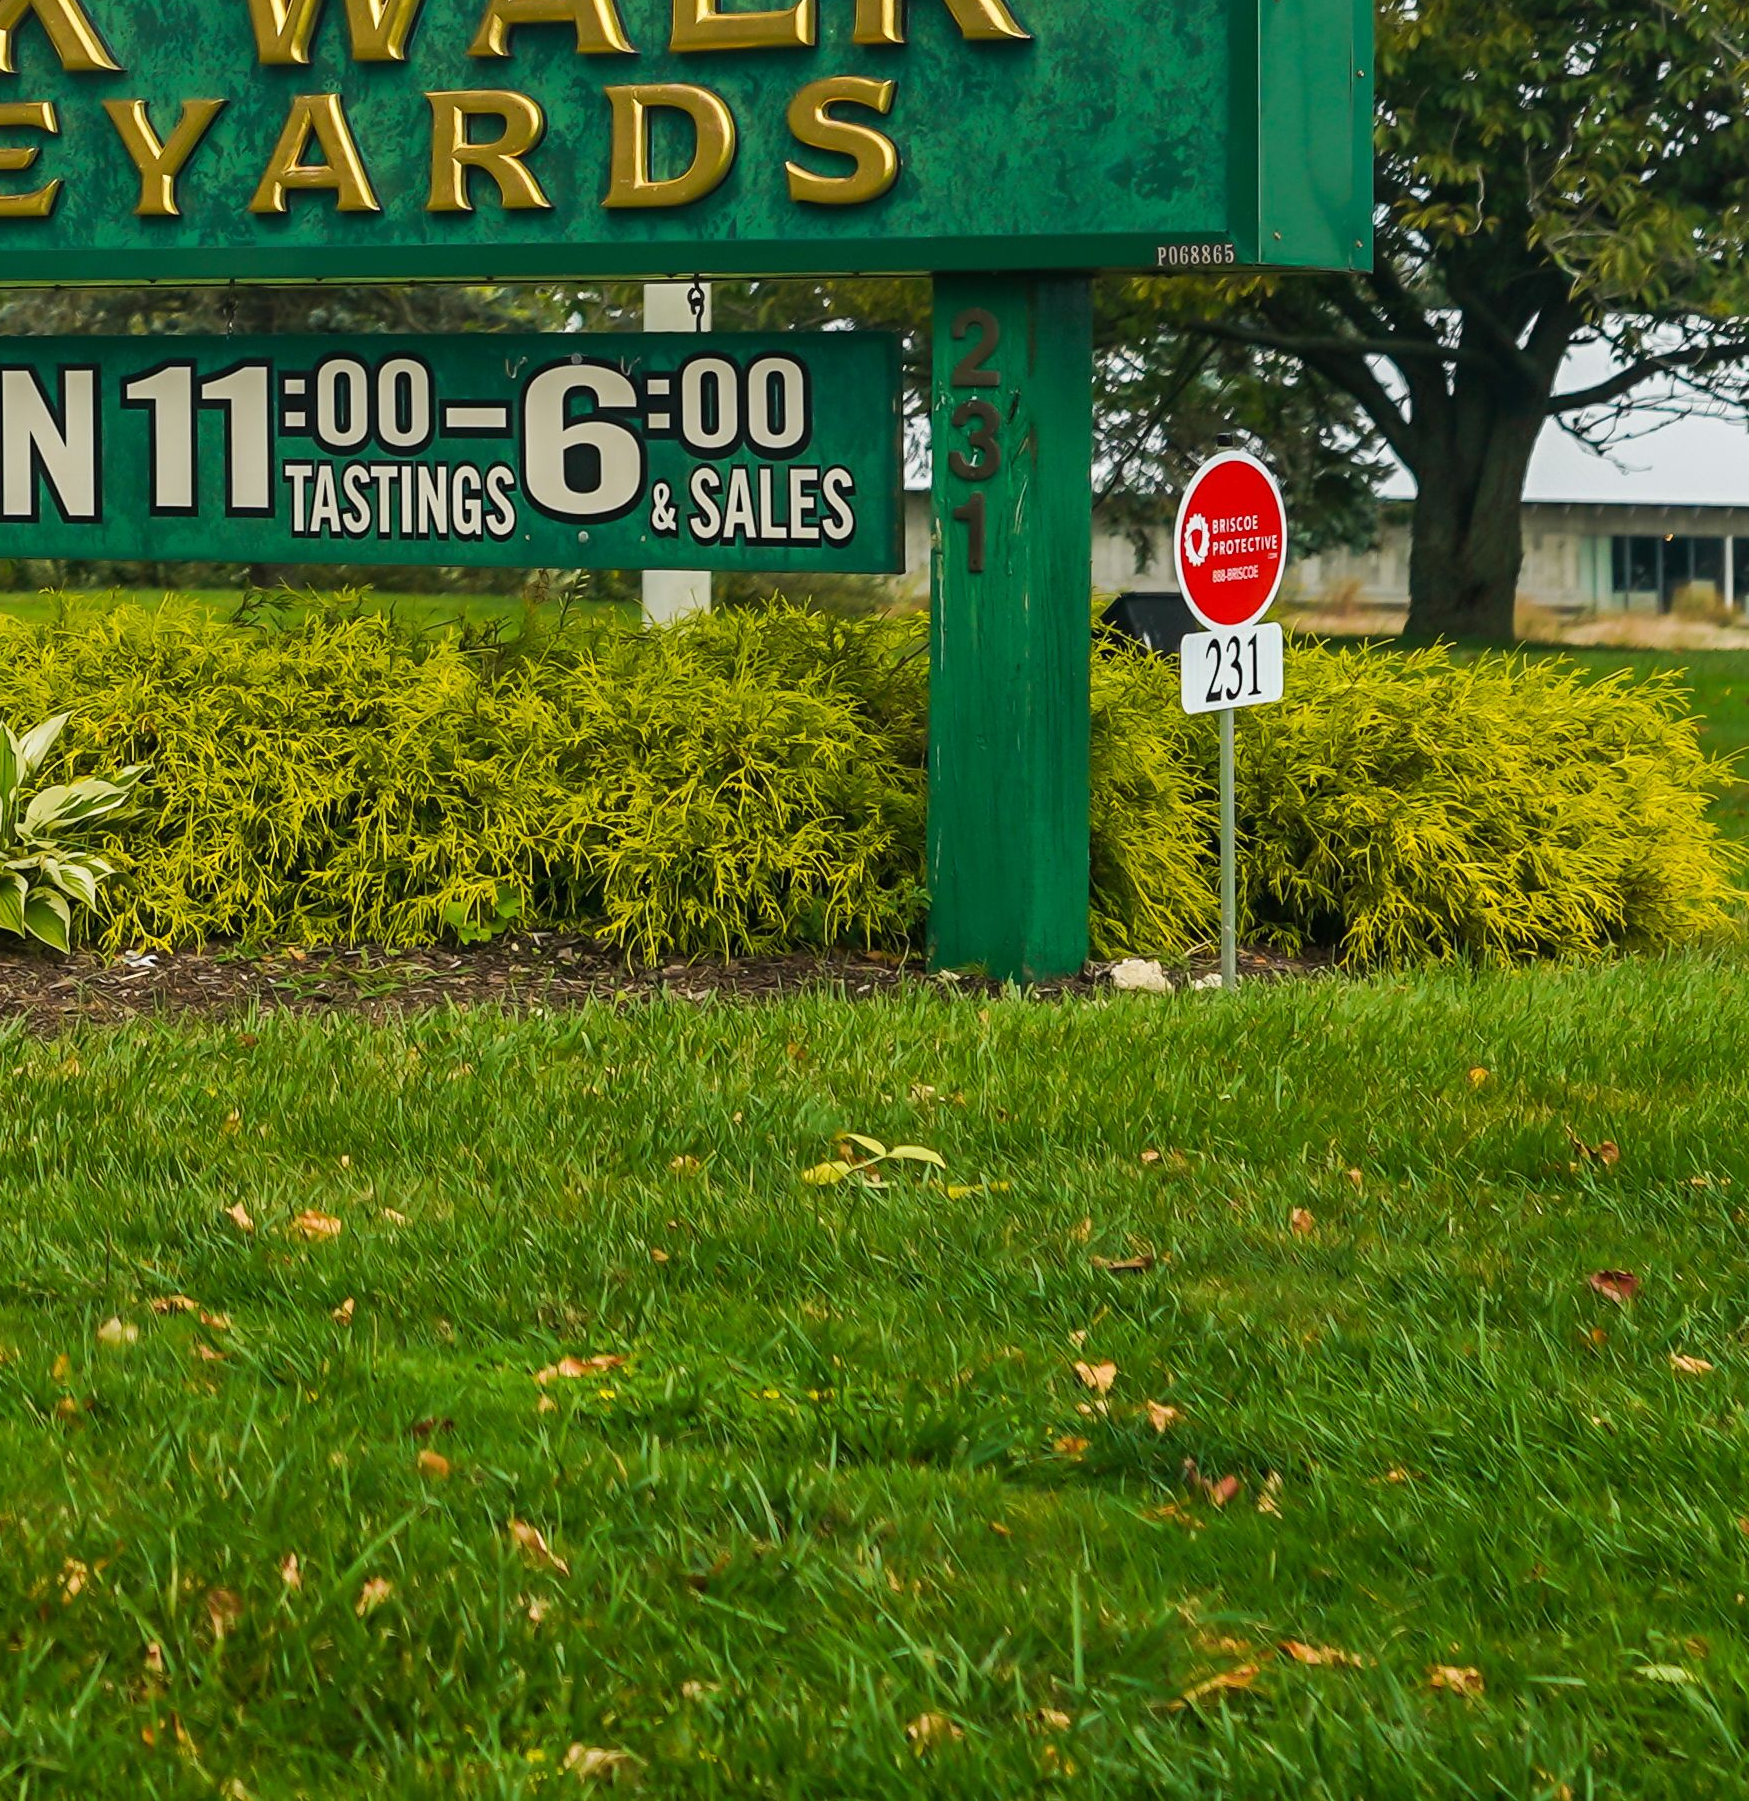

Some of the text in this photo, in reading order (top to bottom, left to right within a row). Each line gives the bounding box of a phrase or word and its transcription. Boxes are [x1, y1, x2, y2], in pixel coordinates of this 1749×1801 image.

[1157, 243, 1235, 267] P068865
[948, 306, 1002, 574] 231
[283, 462, 856, 545] TASTINGS & SALES
[1212, 515, 1259, 535] BRISCOE
[1212, 534, 1279, 557] PROTECTIVE
[1205, 632, 1262, 703] 231
